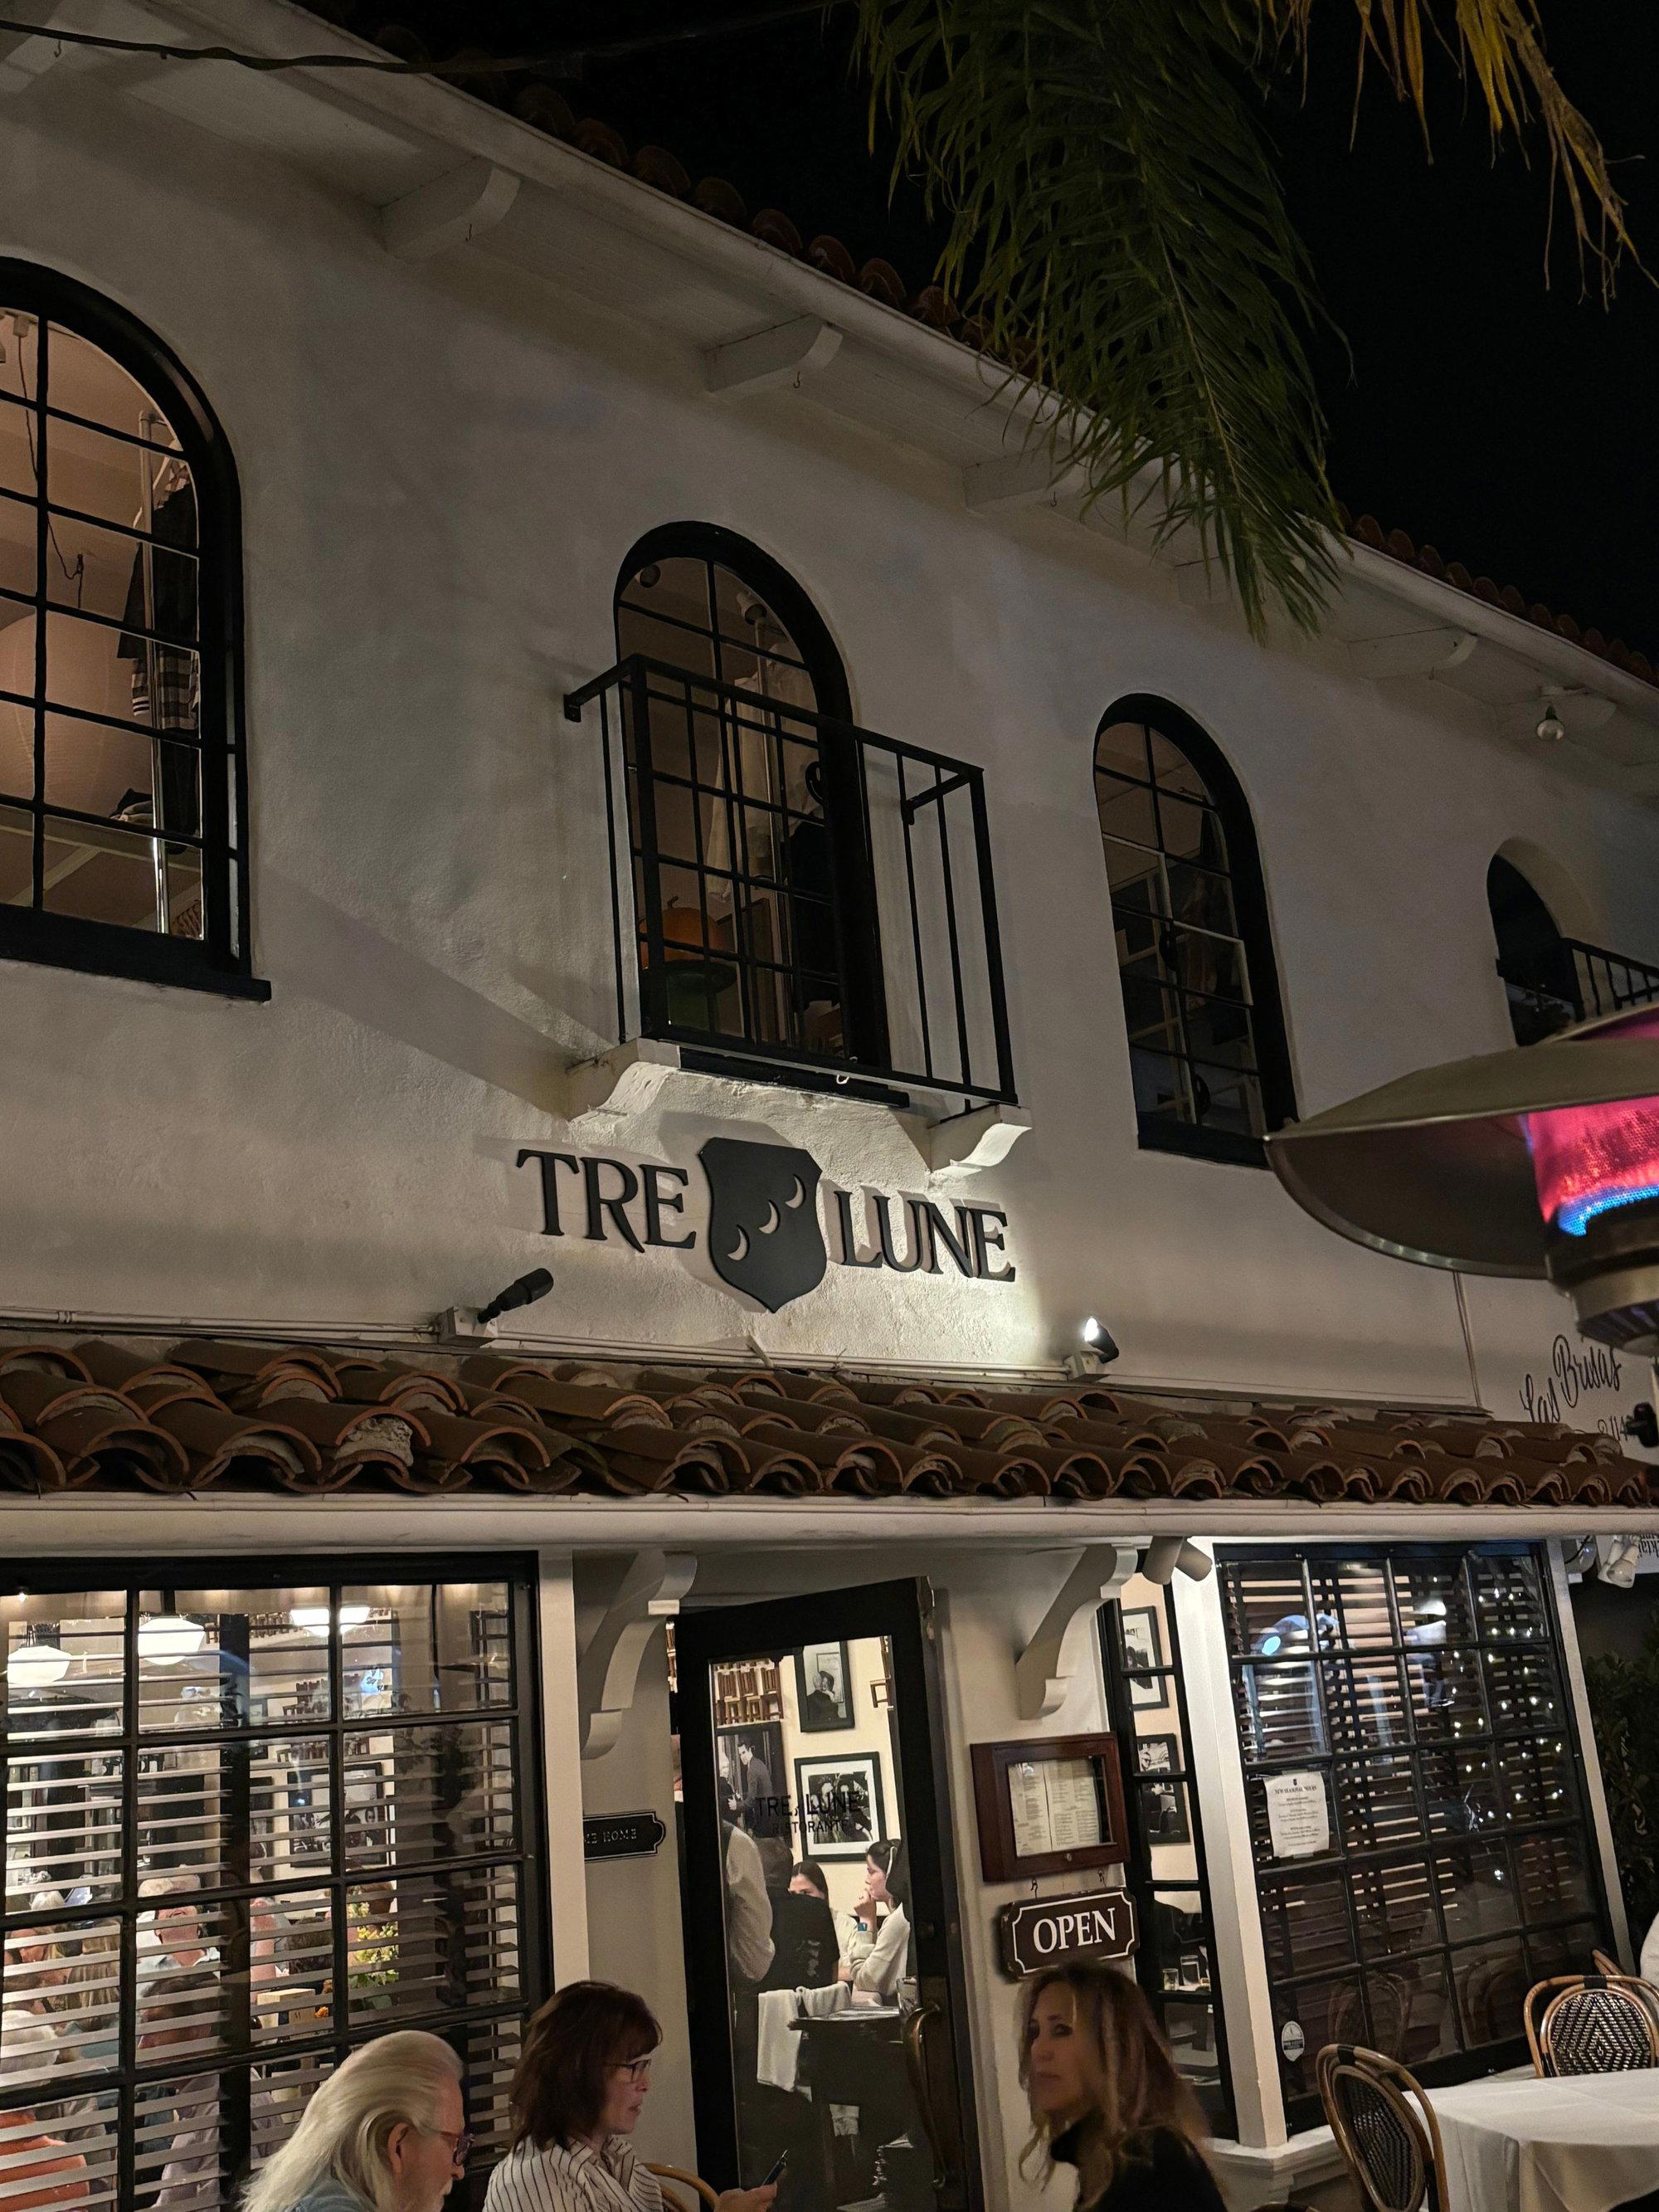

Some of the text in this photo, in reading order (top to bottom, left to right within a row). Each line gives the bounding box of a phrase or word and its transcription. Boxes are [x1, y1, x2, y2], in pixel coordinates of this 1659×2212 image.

[518, 1149, 1015, 1282] TRE LUNE
[755, 1791, 861, 1816] TRE LUNE
[1033, 1907, 1116, 1954] OPEN
